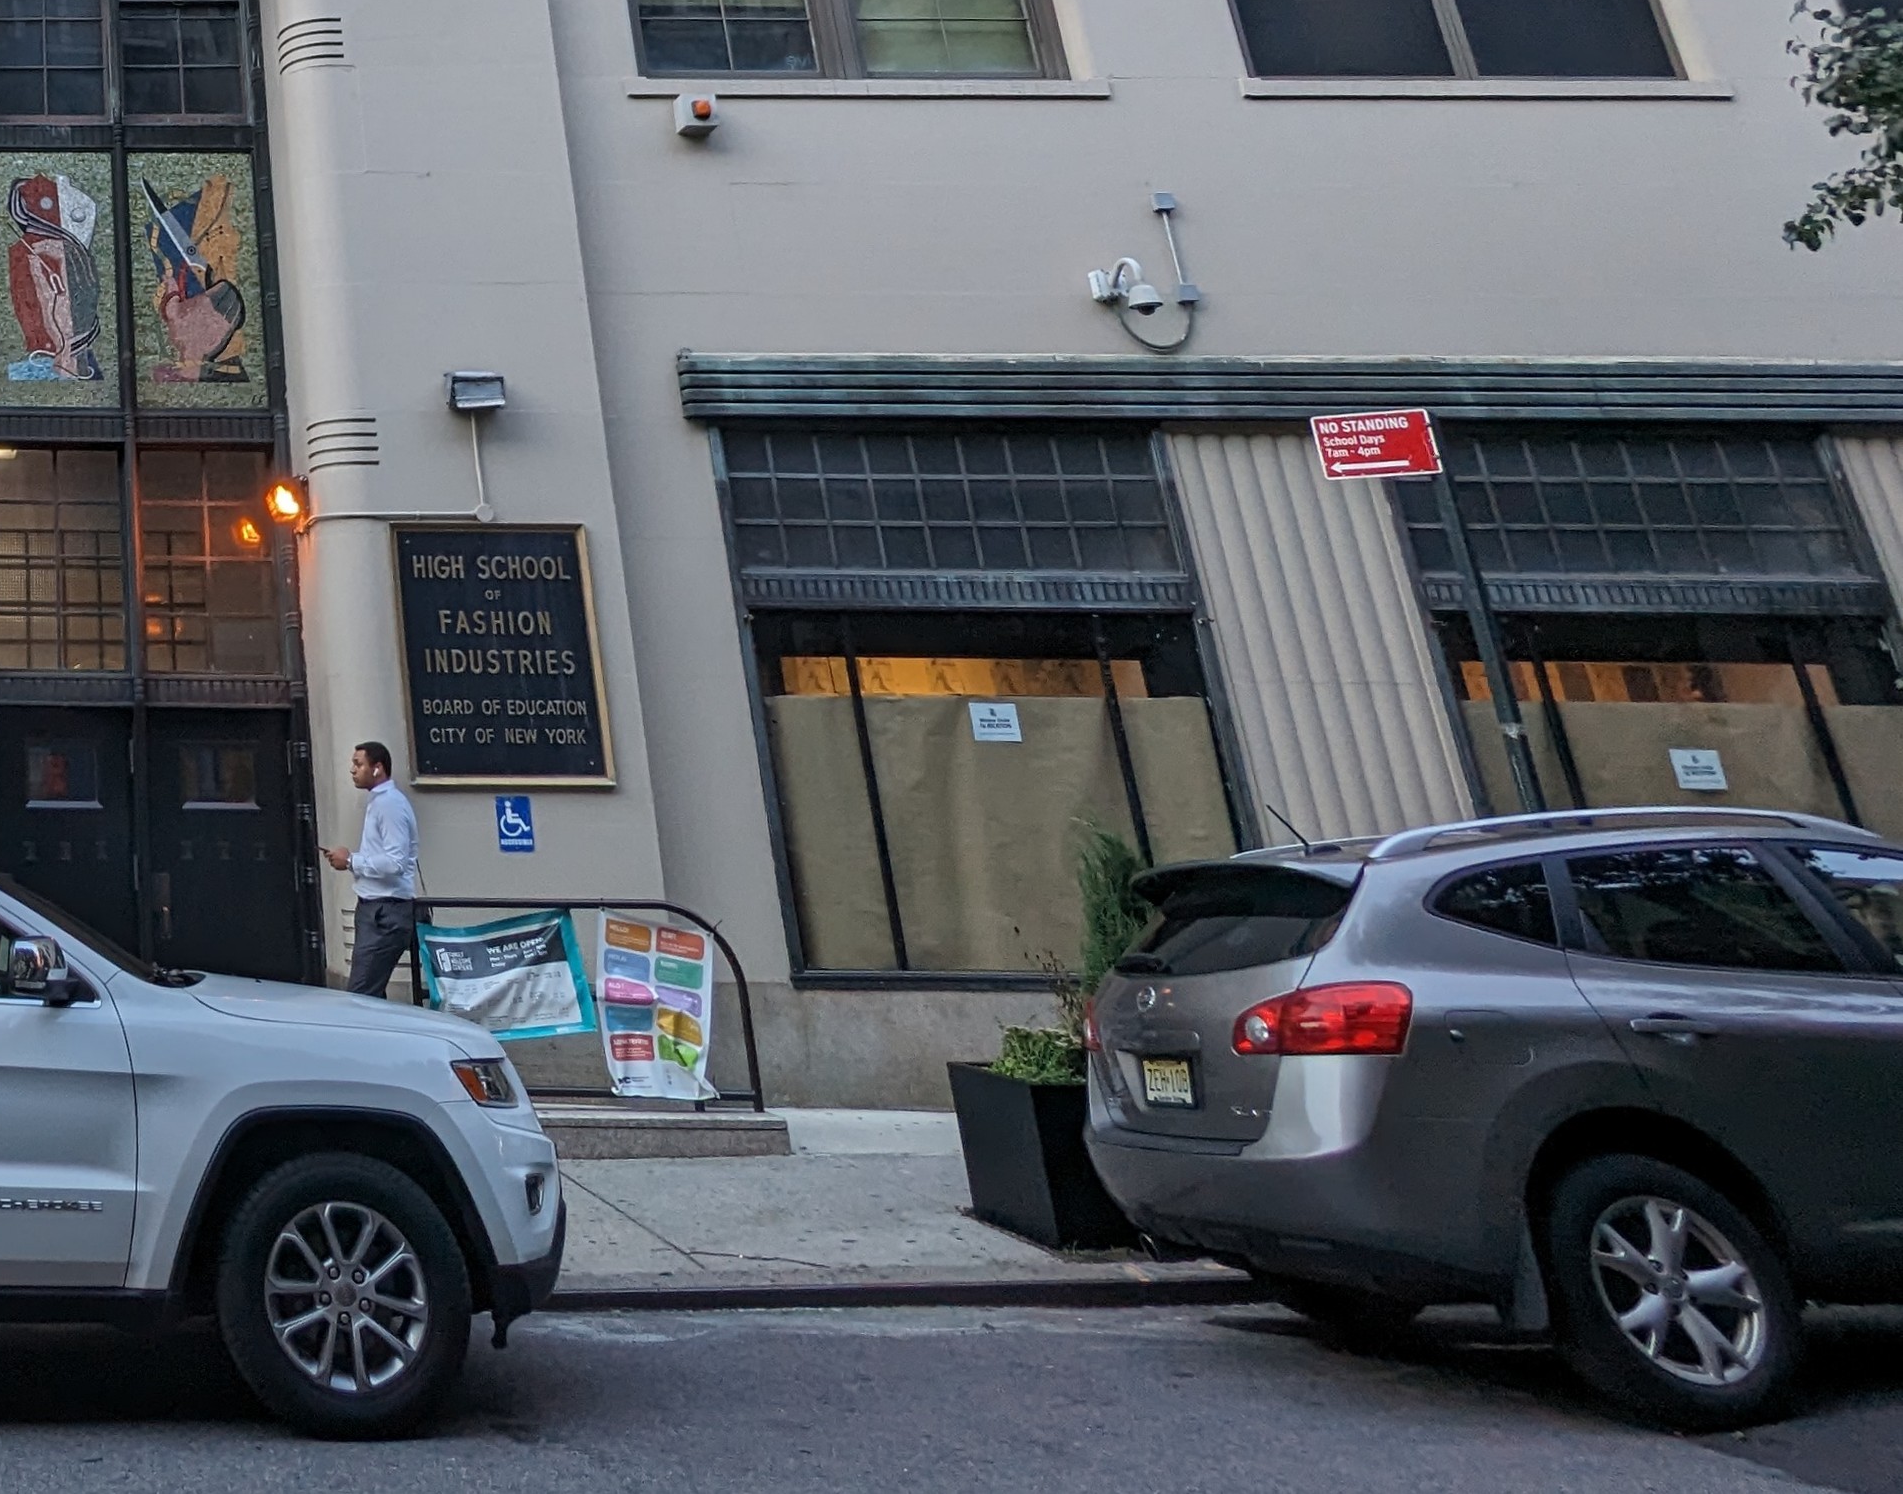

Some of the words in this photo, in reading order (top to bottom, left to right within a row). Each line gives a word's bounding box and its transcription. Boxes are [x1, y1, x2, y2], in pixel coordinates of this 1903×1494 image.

[1318, 421, 1339, 434] NO
[1340, 416, 1409, 433] STANDING
[1322, 434, 1358, 447] School
[1359, 433, 1386, 447] Days
[1325, 448, 1349, 458] 7am
[1357, 446, 1381, 458] 4pm
[412, 554, 465, 579] HIGH
[476, 555, 571, 580] SCHOOL
[484, 589, 501, 600] OF
[438, 609, 552, 636] FASHION
[424, 648, 576, 675] INDUSTRIES
[422, 699, 474, 715] BOARD
[481, 699, 501, 715] OF
[507, 699, 588, 716] EDUCATION
[429, 727, 466, 743] CITY
[475, 728, 495, 743] OF
[505, 727, 538, 745] NEW
[545, 728, 587, 745] YORK
